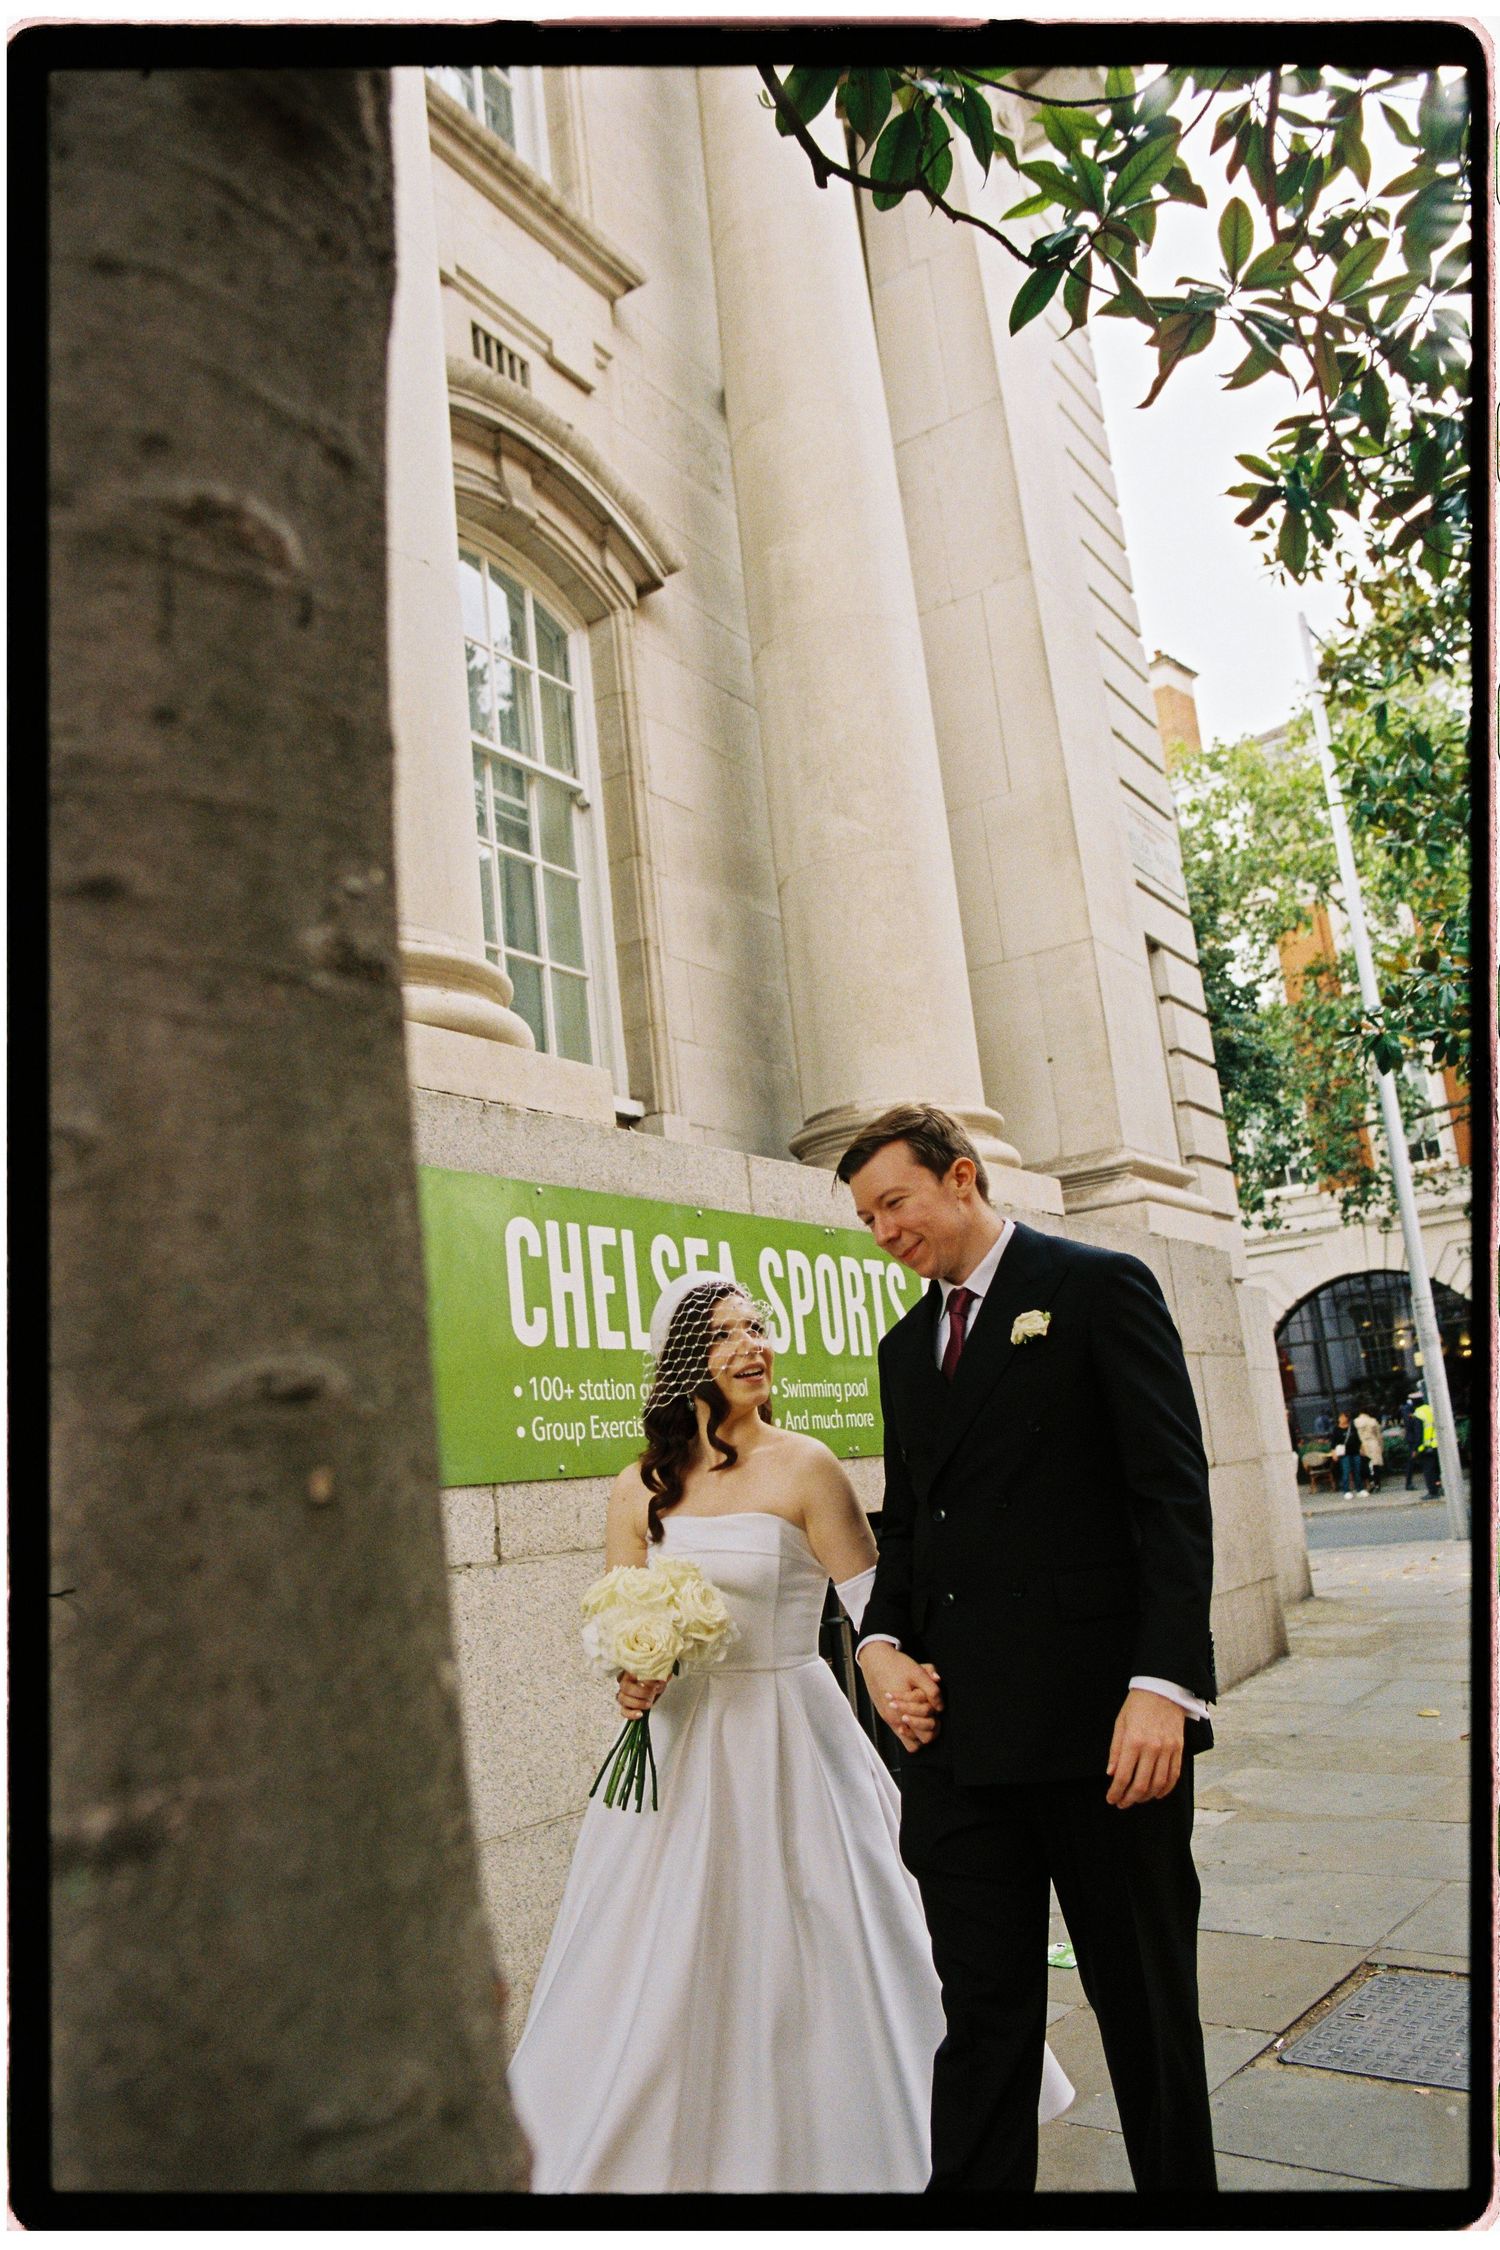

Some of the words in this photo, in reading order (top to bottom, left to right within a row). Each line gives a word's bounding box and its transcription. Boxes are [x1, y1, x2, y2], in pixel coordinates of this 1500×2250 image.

[758, 1246, 908, 1357] SPORTS
[528, 1375, 575, 1402] 100+
[578, 1378, 637, 1401] station
[780, 1377, 843, 1403] Swimming
[844, 1377, 869, 1403] pool
[531, 1415, 587, 1447] Group
[589, 1415, 646, 1440] Exercis
[785, 1409, 810, 1431] And
[811, 1408, 844, 1430] much
[846, 1411, 875, 1428] more
